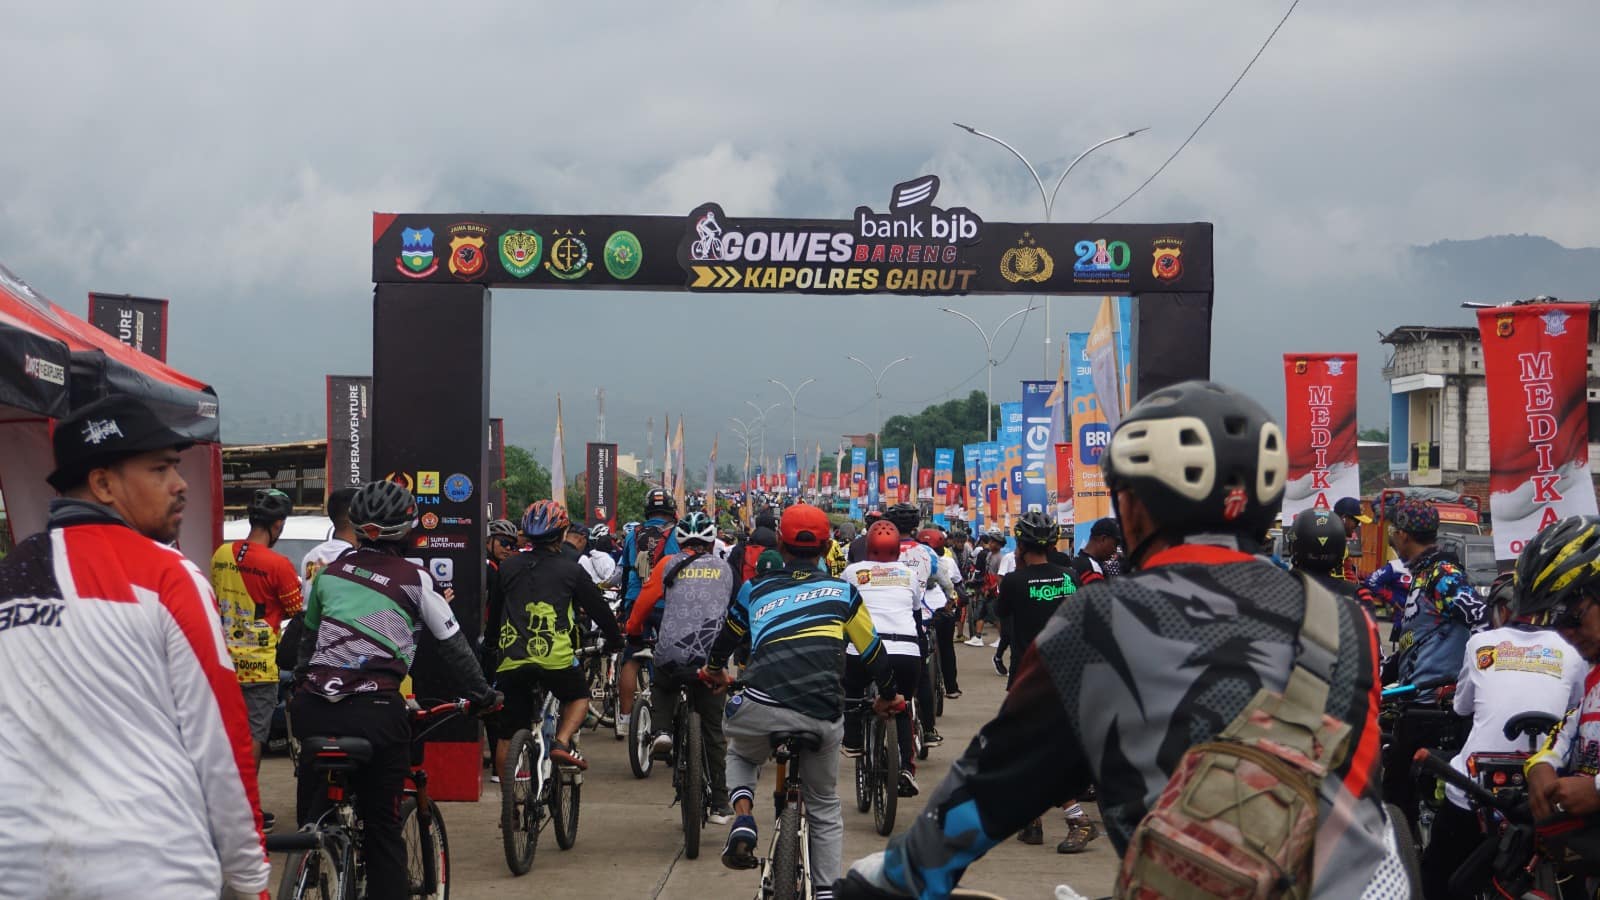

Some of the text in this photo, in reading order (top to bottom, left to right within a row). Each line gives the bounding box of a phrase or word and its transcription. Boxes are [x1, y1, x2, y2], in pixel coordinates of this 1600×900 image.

[861, 213, 977, 243] bank bjb
[722, 232, 854, 262] GOWES
[854, 245, 957, 263] BARENG
[743, 266, 977, 290] KAPOLRES GARUT
[350, 384, 360, 484] SUPERADVENTURE
[1085, 431, 1111, 447] BRI
[1518, 351, 1563, 533] MEDIKA
[1309, 386, 1333, 510] MEDIKA
[417, 496, 440, 504] PLN
[795, 587, 843, 604] RIDE
